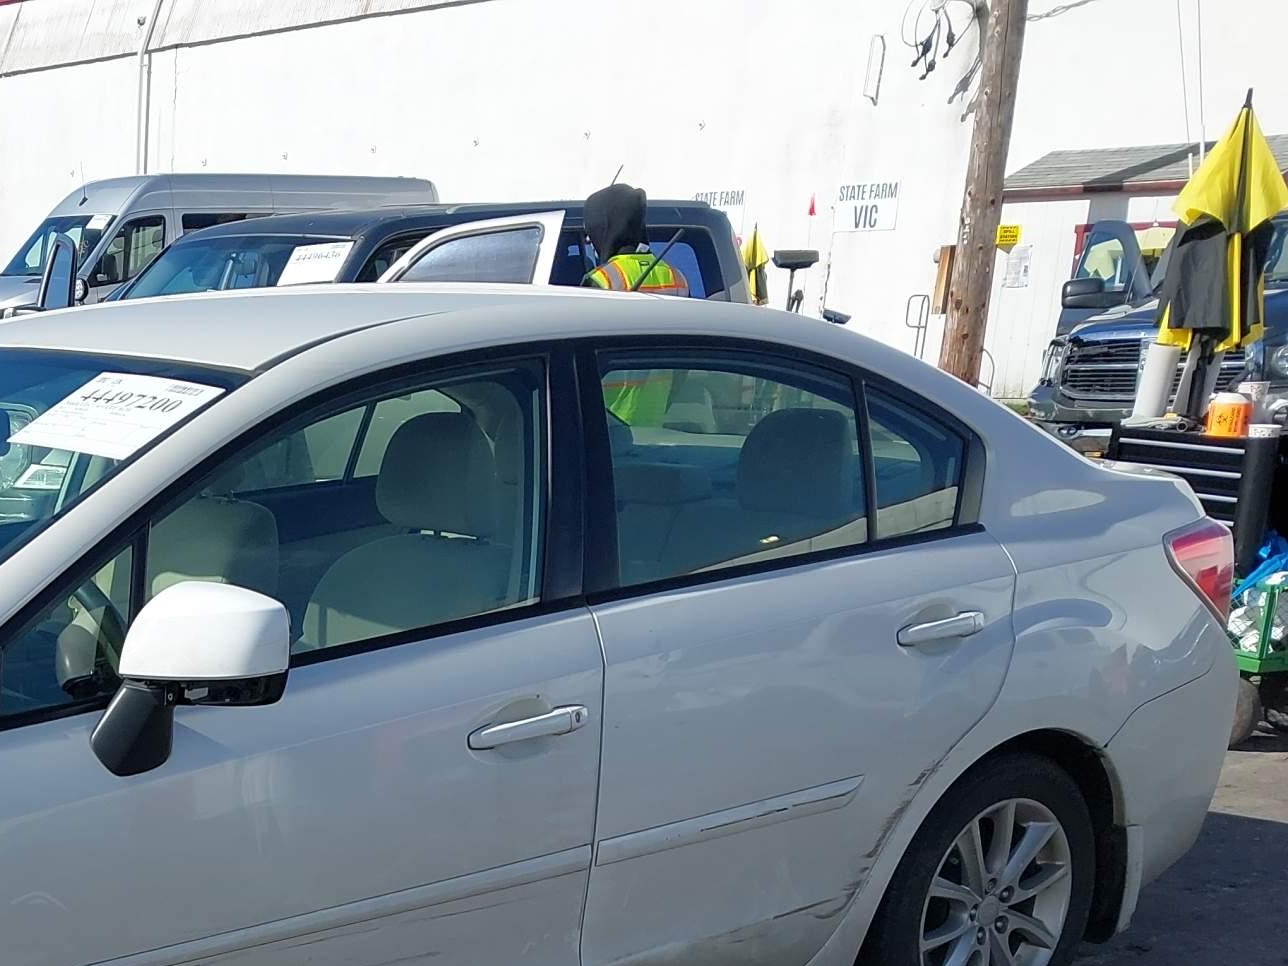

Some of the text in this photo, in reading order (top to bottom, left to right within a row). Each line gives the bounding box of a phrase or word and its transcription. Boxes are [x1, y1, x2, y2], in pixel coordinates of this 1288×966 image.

[719, 190, 744, 206] FARM
[839, 182, 898, 202] STATE FARM
[854, 204, 879, 229] VIC
[81, 389, 183, 413] 44497200
